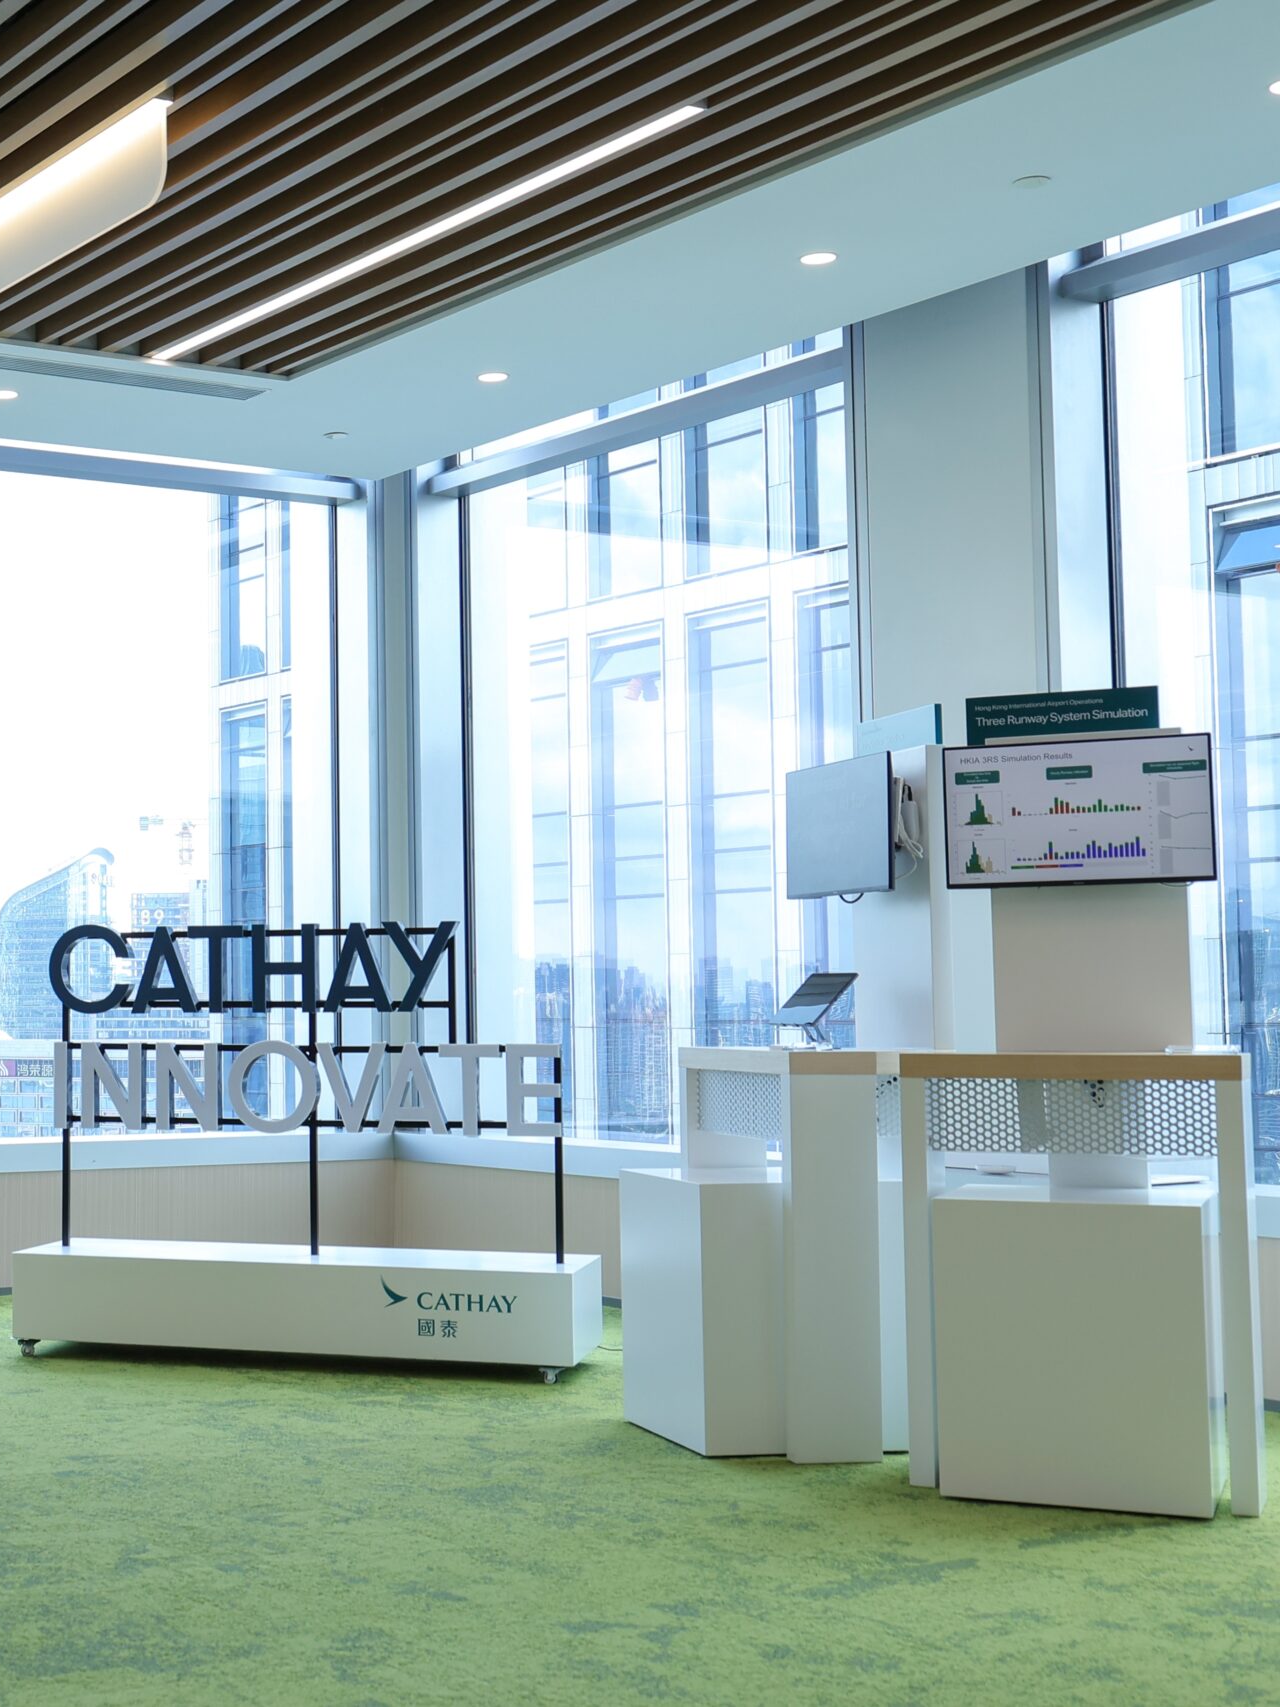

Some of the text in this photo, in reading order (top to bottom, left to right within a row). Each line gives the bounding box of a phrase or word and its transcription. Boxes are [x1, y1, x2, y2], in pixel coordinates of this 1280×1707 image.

[1008, 701, 1046, 709] International
[1069, 698, 1104, 706] Operations
[975, 707, 1149, 727] Three Runway System Simulation
[960, 752, 1073, 765] HKIA 3RS Simulation Results
[49, 921, 460, 1014] CATHAY
[17, 1063, 53, 1077] 鸿荣源
[54, 1040, 563, 1138] INNOVATE
[416, 1291, 518, 1314] CATHAY
[417, 1318, 458, 1338] 國泰
